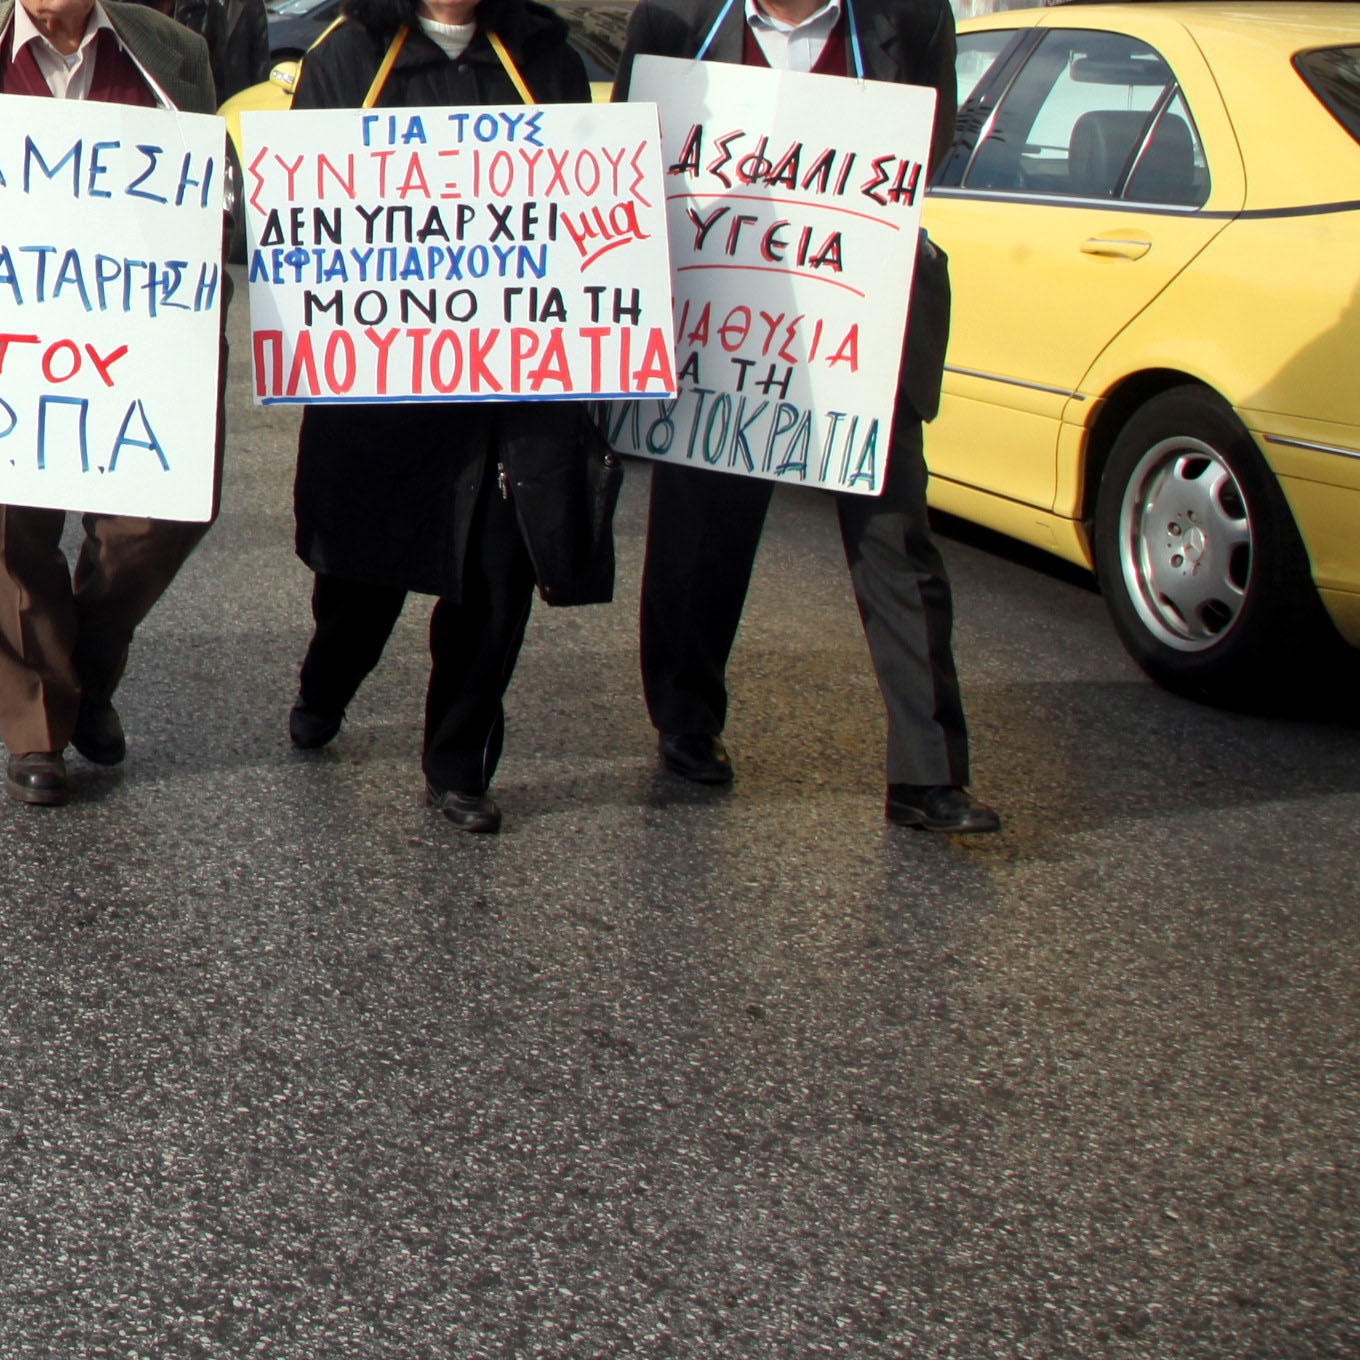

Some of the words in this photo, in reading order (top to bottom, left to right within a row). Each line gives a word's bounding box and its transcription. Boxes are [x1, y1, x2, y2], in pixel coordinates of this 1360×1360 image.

[361, 115, 427, 146] ΓΙΑ
[448, 111, 544, 147] ΤΟΥΣ
[249, 140, 652, 216] ΣΥΝΤΑΞΙΟΥΧΟΥΣ
[667, 124, 922, 206] ΑΣΦΑΛΙΣΗ
[259, 206, 343, 247] ΔΕΝ
[355, 202, 557, 244] ΥΠΑΡΧΕΙ
[686, 207, 843, 273] ΥΓΕΙΑ
[249, 248, 348, 284] ΛΕΦΤΑ
[353, 244, 547, 283] ΥΠΑΡΧΟΥΝ
[304, 288, 478, 326] ΜΟΝΟ
[503, 287, 567, 323] ΓΙΑ
[584, 286, 642, 326] ΤΗ
[253, 326, 676, 397] ΠΛΟΥΤΟΚΡΑΤΙΑ
[731, 358, 794, 399] ΤΗ
